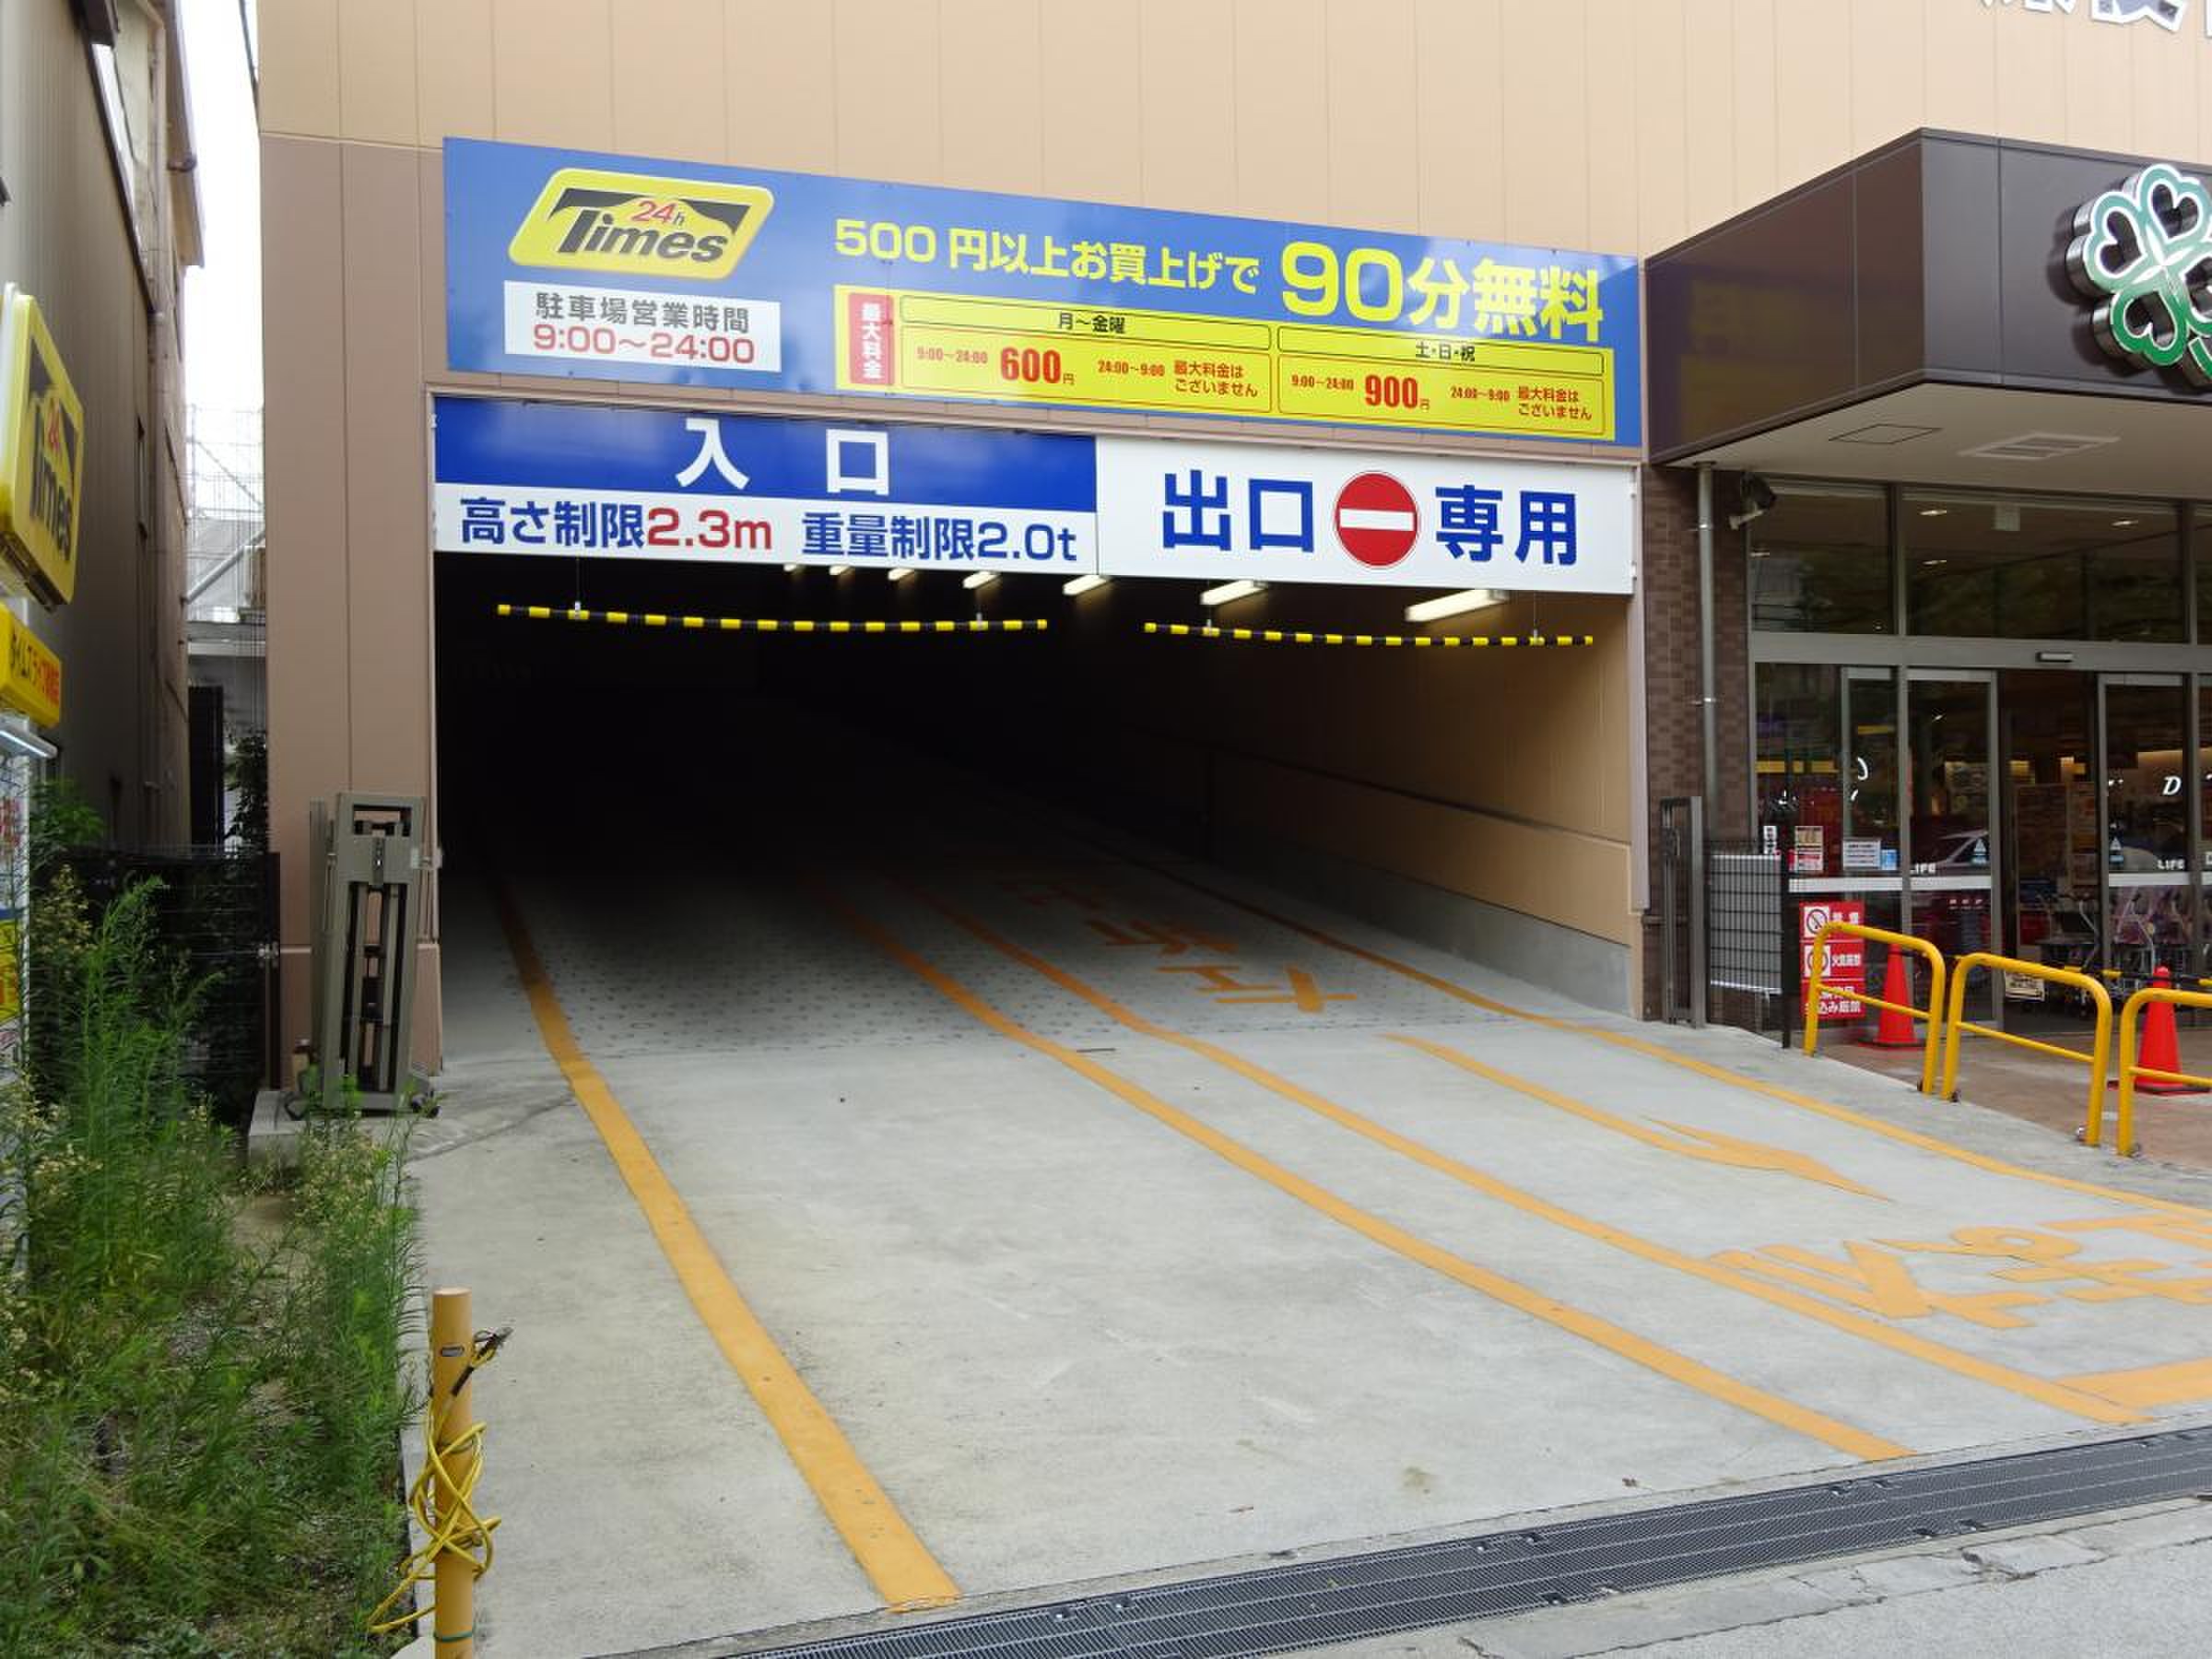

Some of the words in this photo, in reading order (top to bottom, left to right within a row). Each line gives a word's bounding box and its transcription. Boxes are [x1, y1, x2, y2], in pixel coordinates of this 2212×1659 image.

[558, 209, 728, 262] Times
[535, 292, 749, 334] 駐車場営業時間
[1175, 378, 1259, 398] ございません
[1519, 403, 1593, 421] ございません
[676, 417, 891, 496] 入口
[460, 495, 772, 551] 高さ制限2.3m
[801, 511, 1077, 562] 重量制限2.0t
[1162, 468, 1314, 553] 出口
[1434, 484, 1577, 566] 専用
